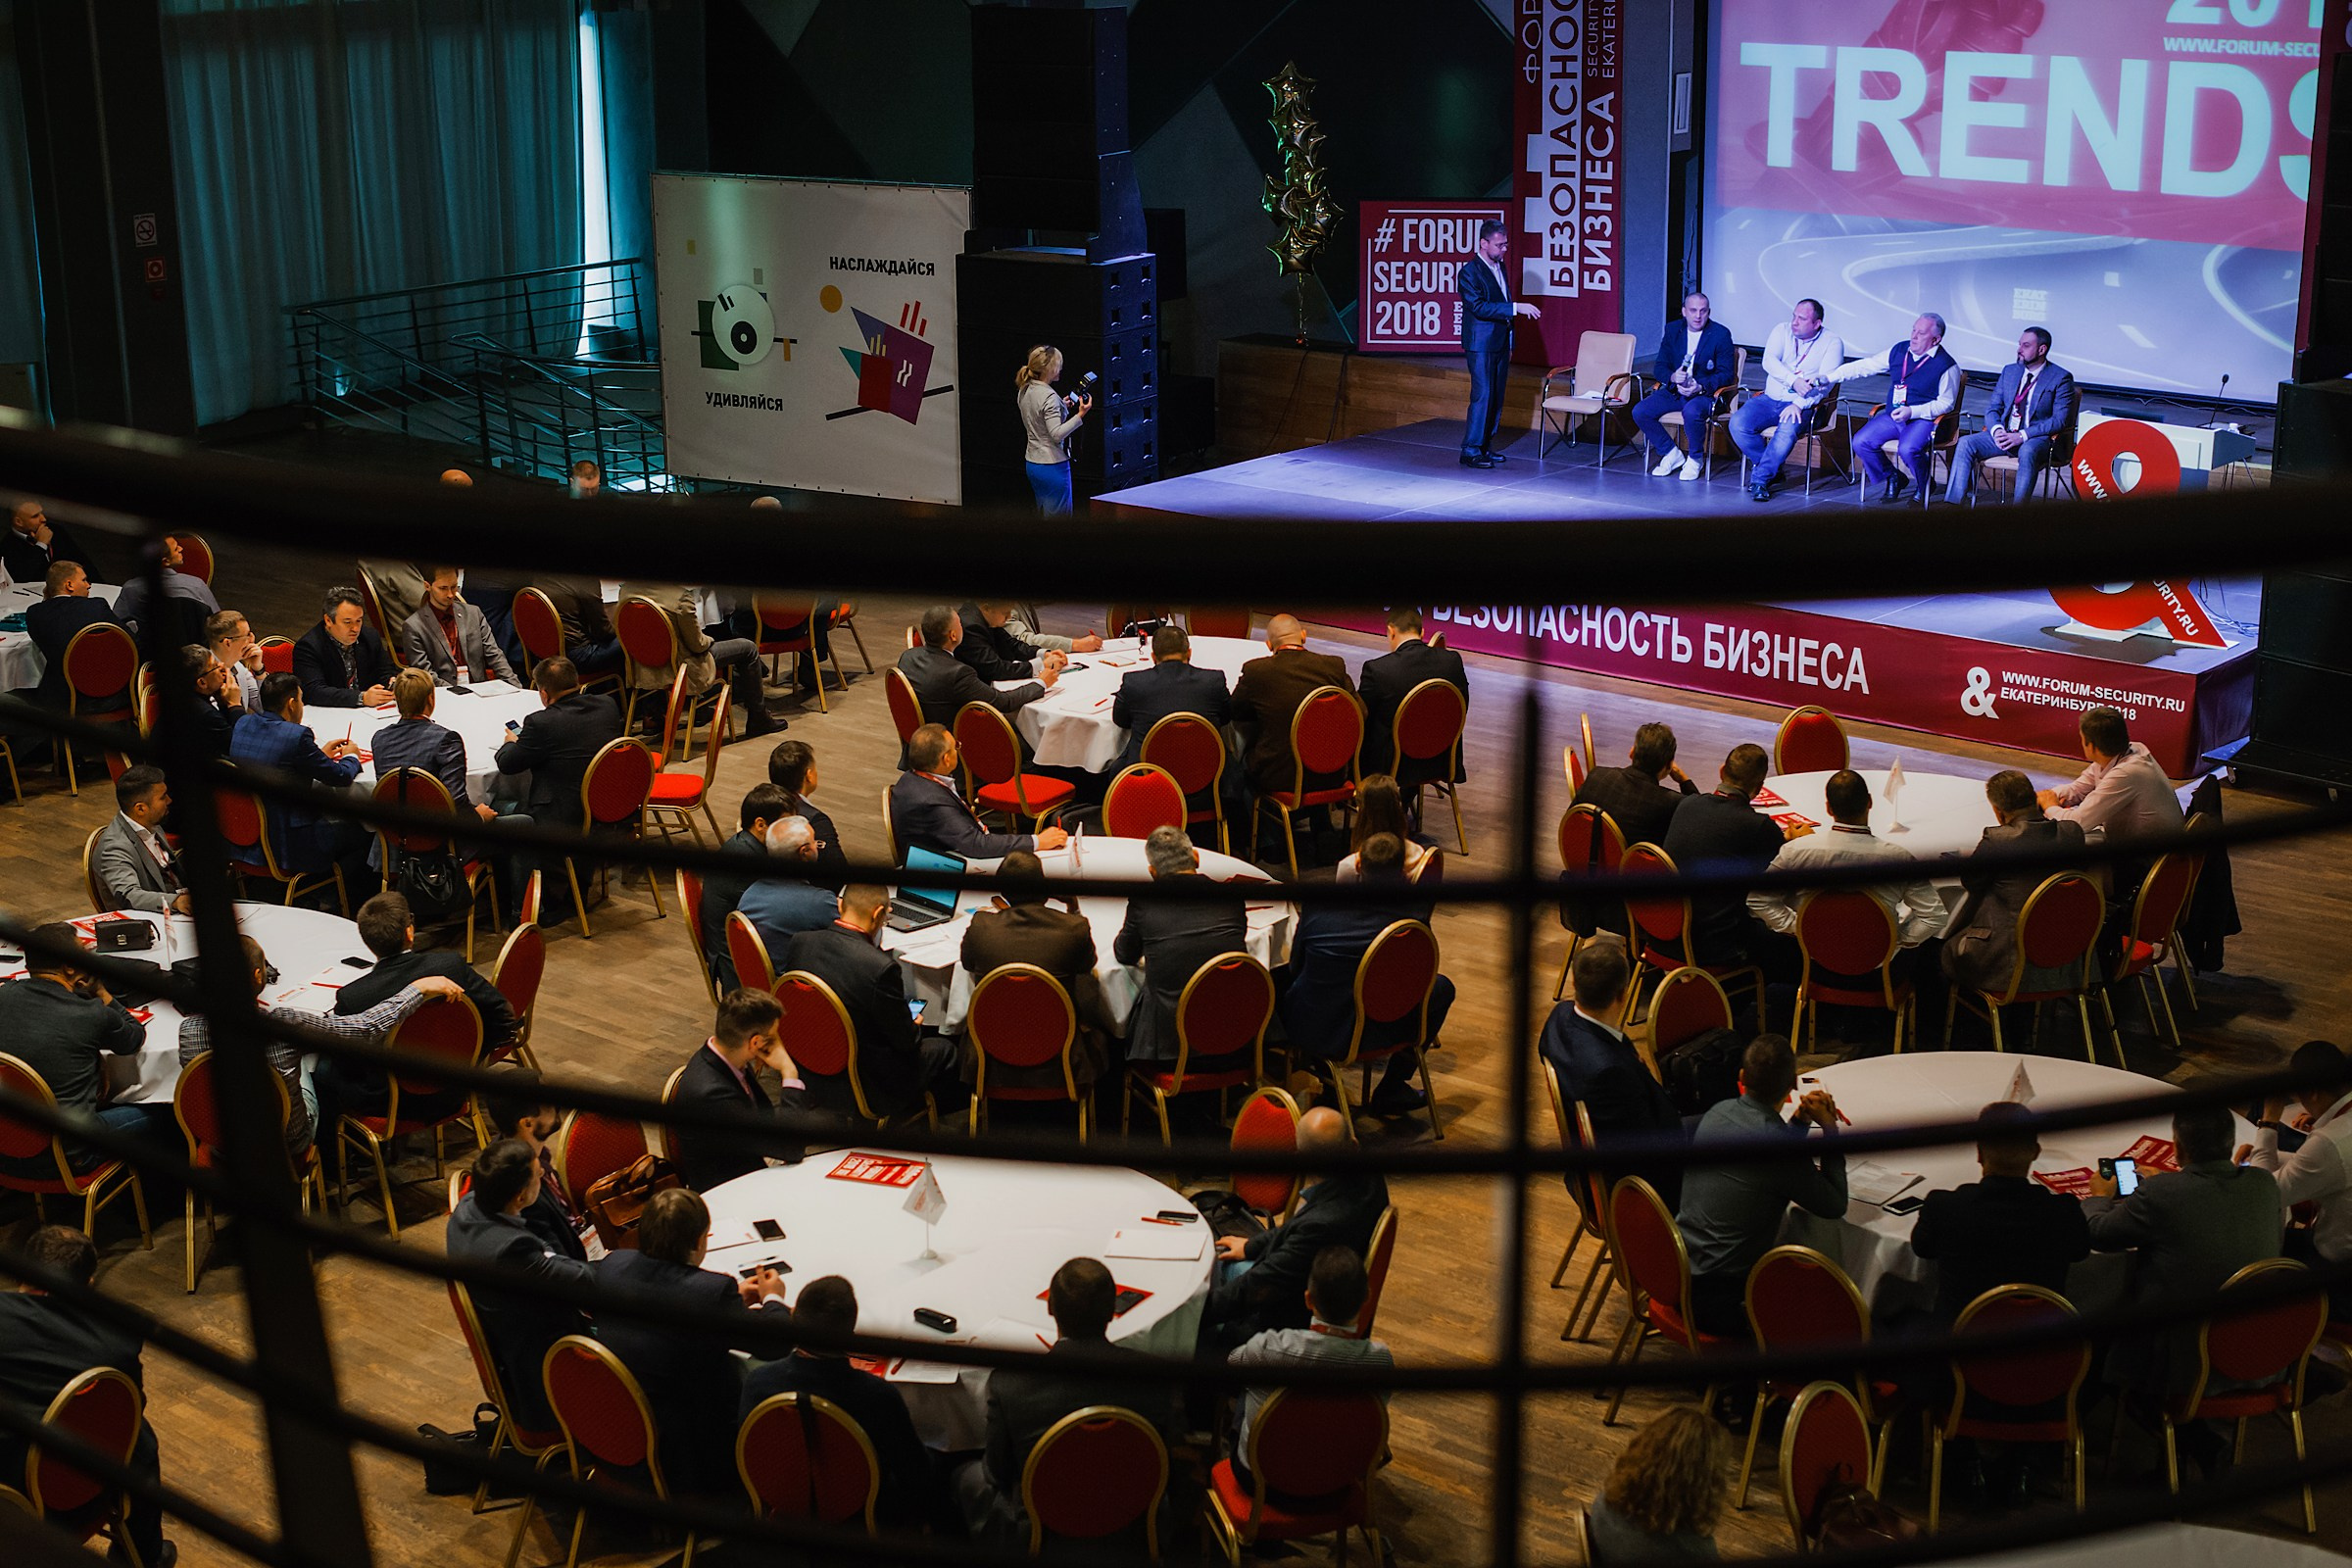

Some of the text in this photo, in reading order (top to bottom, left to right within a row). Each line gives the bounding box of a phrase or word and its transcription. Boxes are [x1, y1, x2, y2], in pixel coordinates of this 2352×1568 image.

[1583, 91, 1615, 291] БИЗНЕСА
[829, 256, 935, 276] НАСЛАЖДАЙСЯ
[1373, 261, 1469, 293] SECURI
[1375, 300, 1442, 335] 2018
[706, 391, 784, 412] УДИВЛЯЙСЯ
[1703, 622, 1870, 695] БИЗНЕСА
[2001, 670, 2185, 712] WWW.FORUM-SECURITY.RU
[2107, 704, 2136, 721] 18
